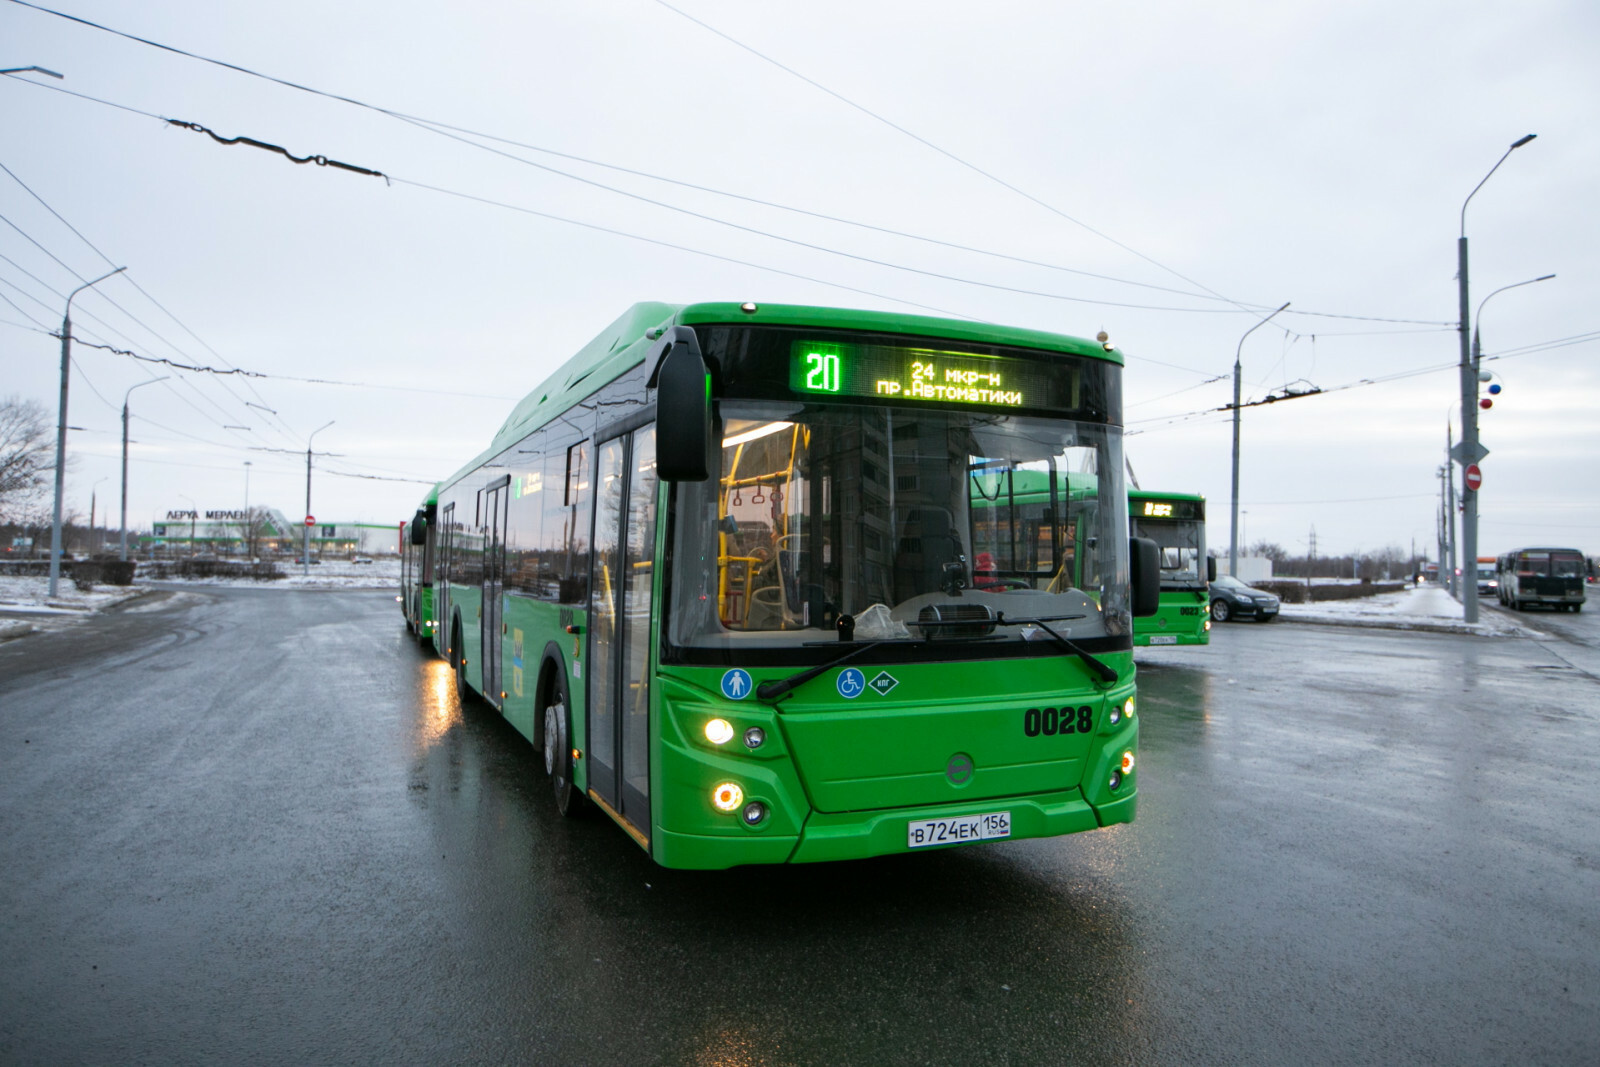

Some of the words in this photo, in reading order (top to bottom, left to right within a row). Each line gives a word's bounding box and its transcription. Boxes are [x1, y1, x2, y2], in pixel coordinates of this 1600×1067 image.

[806, 353, 840, 392] 20
[911, 361, 935, 381] 24
[945, 368, 1001, 387] мкр-н
[1024, 705, 1093, 738] 0028
[915, 820, 979, 843] В724ЕК
[983, 814, 1006, 830] 156
